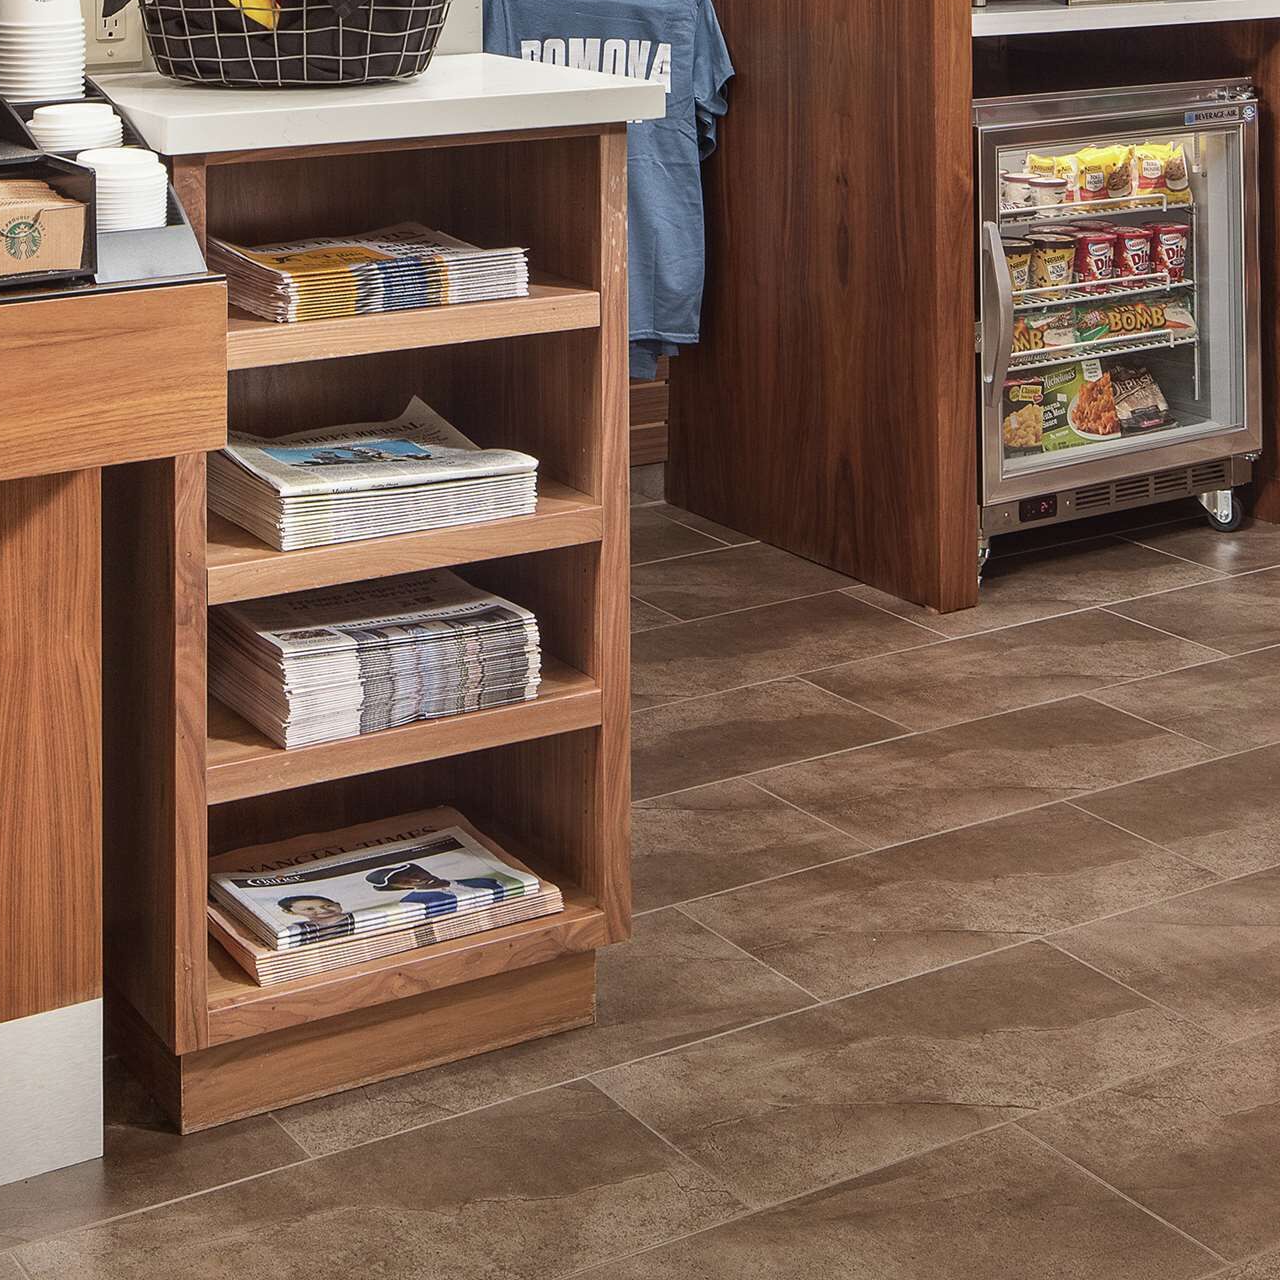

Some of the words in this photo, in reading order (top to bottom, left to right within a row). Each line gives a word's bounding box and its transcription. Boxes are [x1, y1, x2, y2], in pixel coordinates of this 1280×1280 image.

[1108, 306, 1166, 332] BOMB
[1012, 330, 1045, 352] MB
[357, 825, 438, 849] TIMES
